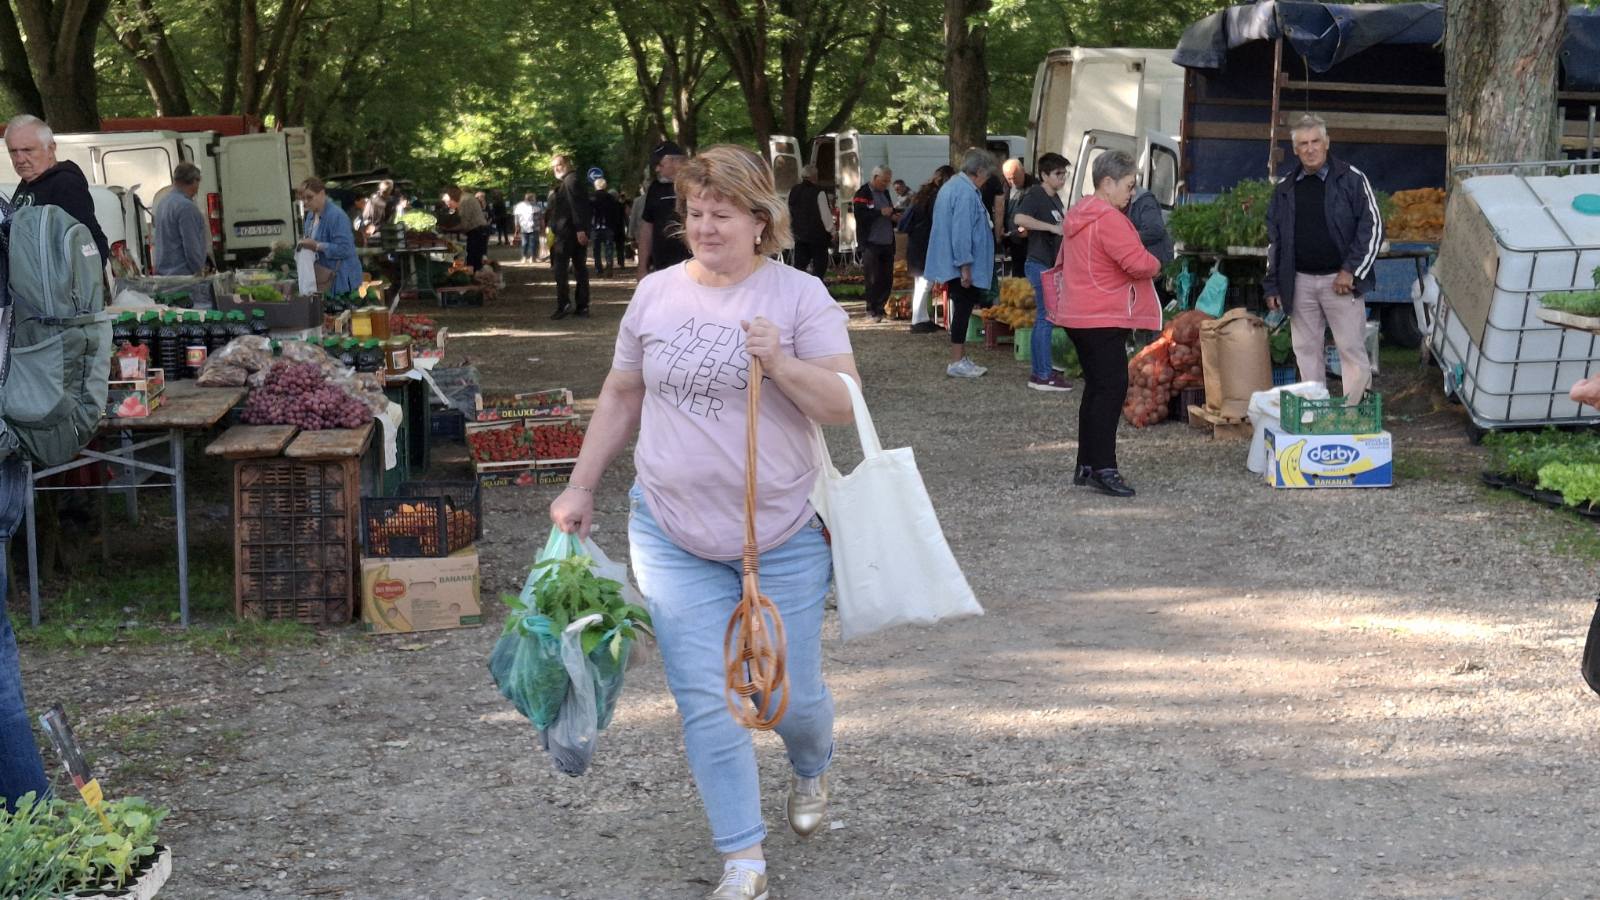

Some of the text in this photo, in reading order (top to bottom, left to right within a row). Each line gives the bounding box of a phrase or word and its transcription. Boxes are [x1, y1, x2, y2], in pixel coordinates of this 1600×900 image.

[675, 317, 747, 347] ACTIV
[695, 357, 750, 391] BES
[502, 408, 534, 418] DELUXE
[659, 381, 724, 422] EVER
[1310, 446, 1358, 464] derby
